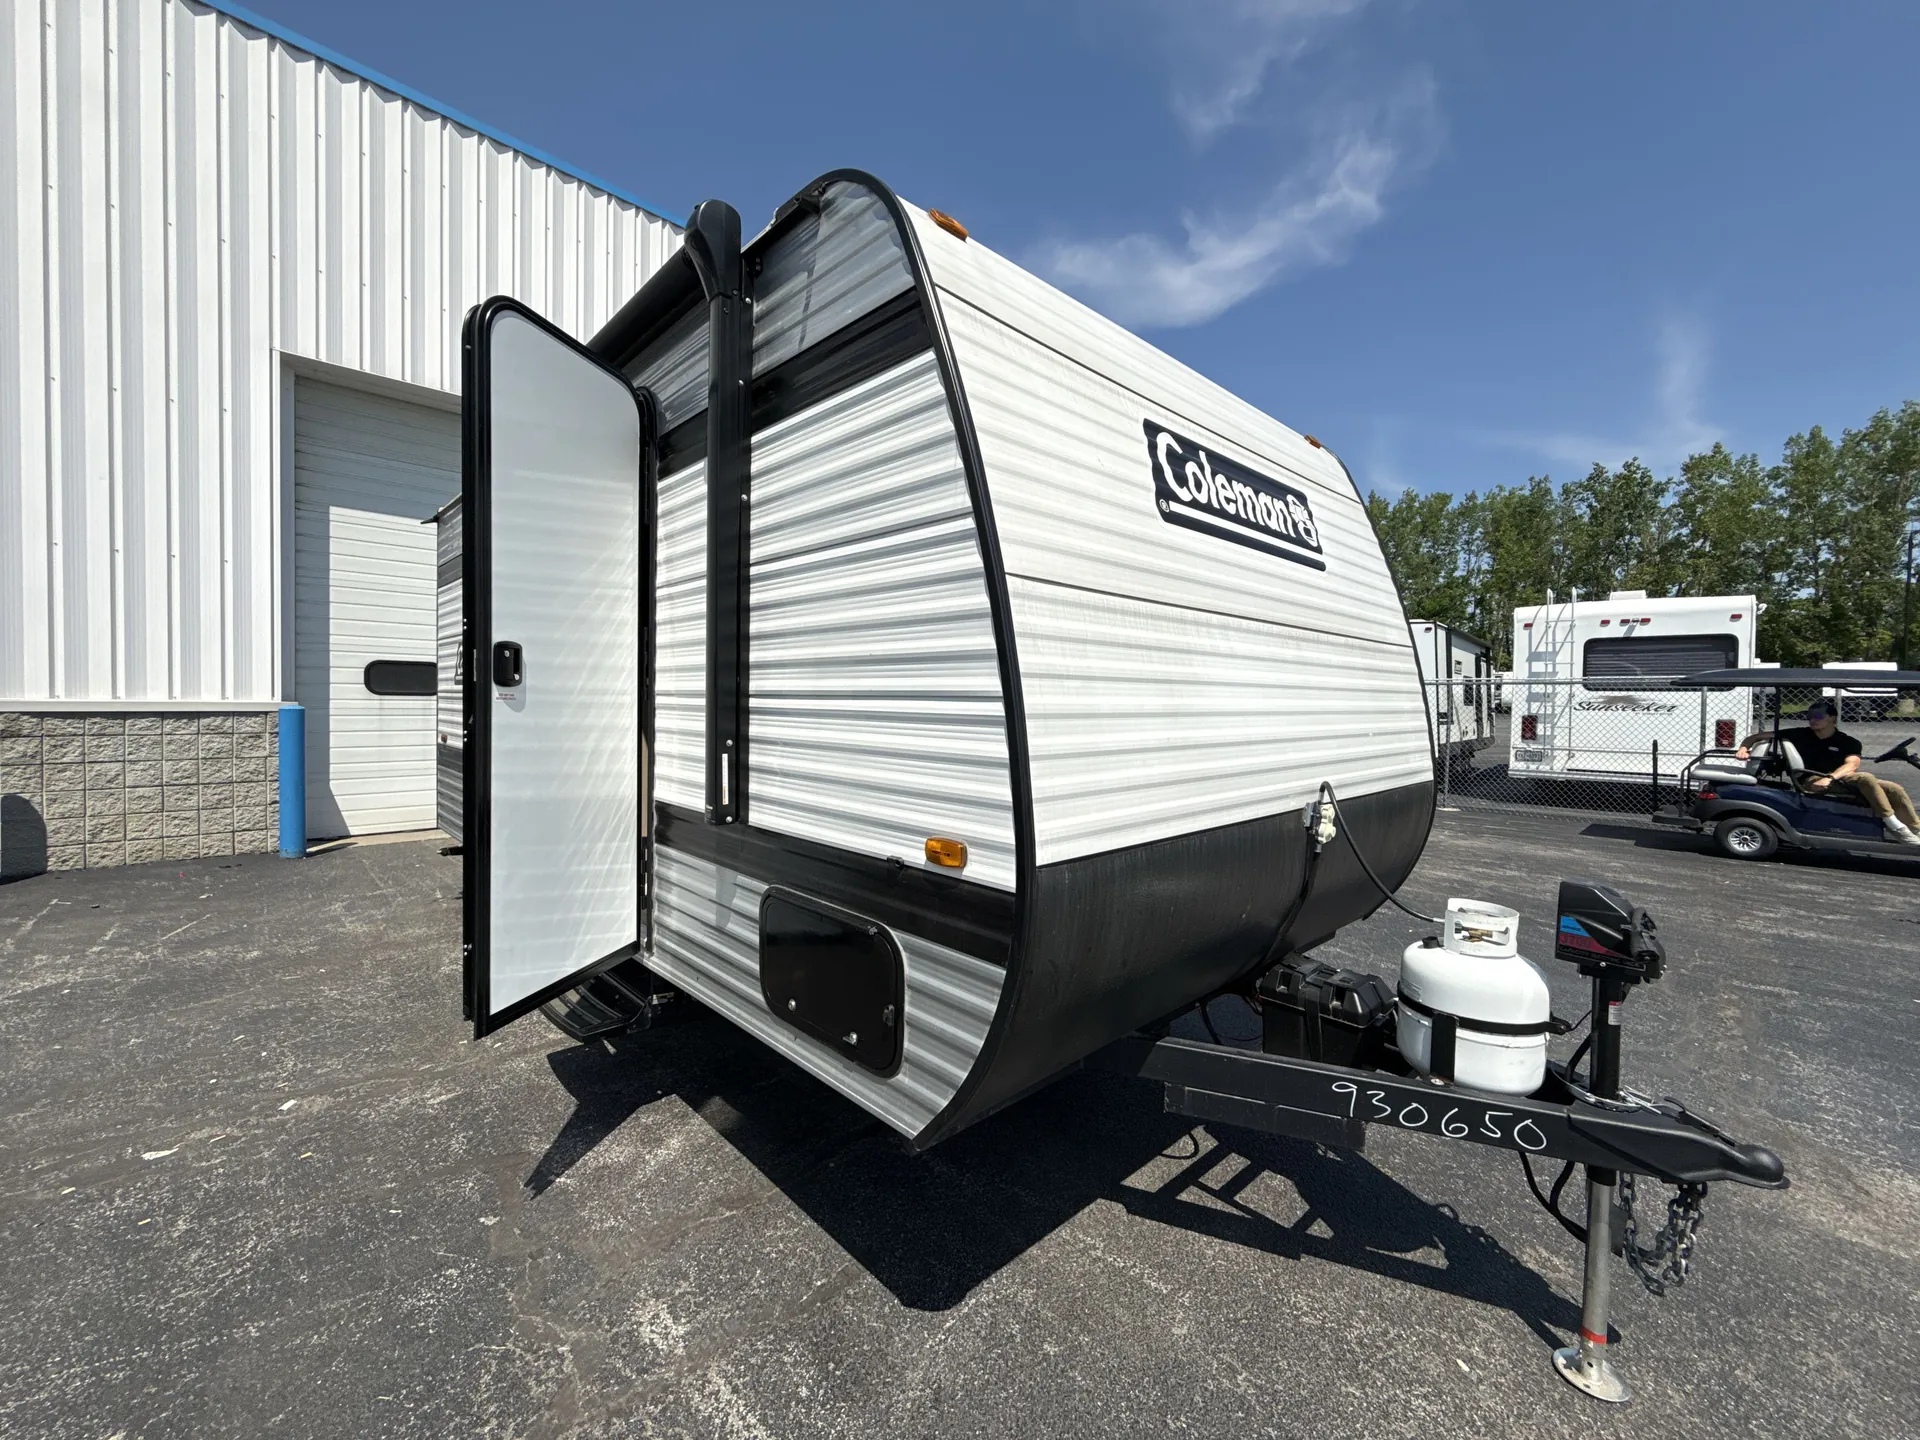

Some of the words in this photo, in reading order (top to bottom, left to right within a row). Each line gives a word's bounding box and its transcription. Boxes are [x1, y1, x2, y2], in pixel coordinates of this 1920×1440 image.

[1156, 431, 1297, 538] Coleman
[1573, 701, 1678, 712] Sunseeker
[1331, 1081, 1547, 1150] 930650
